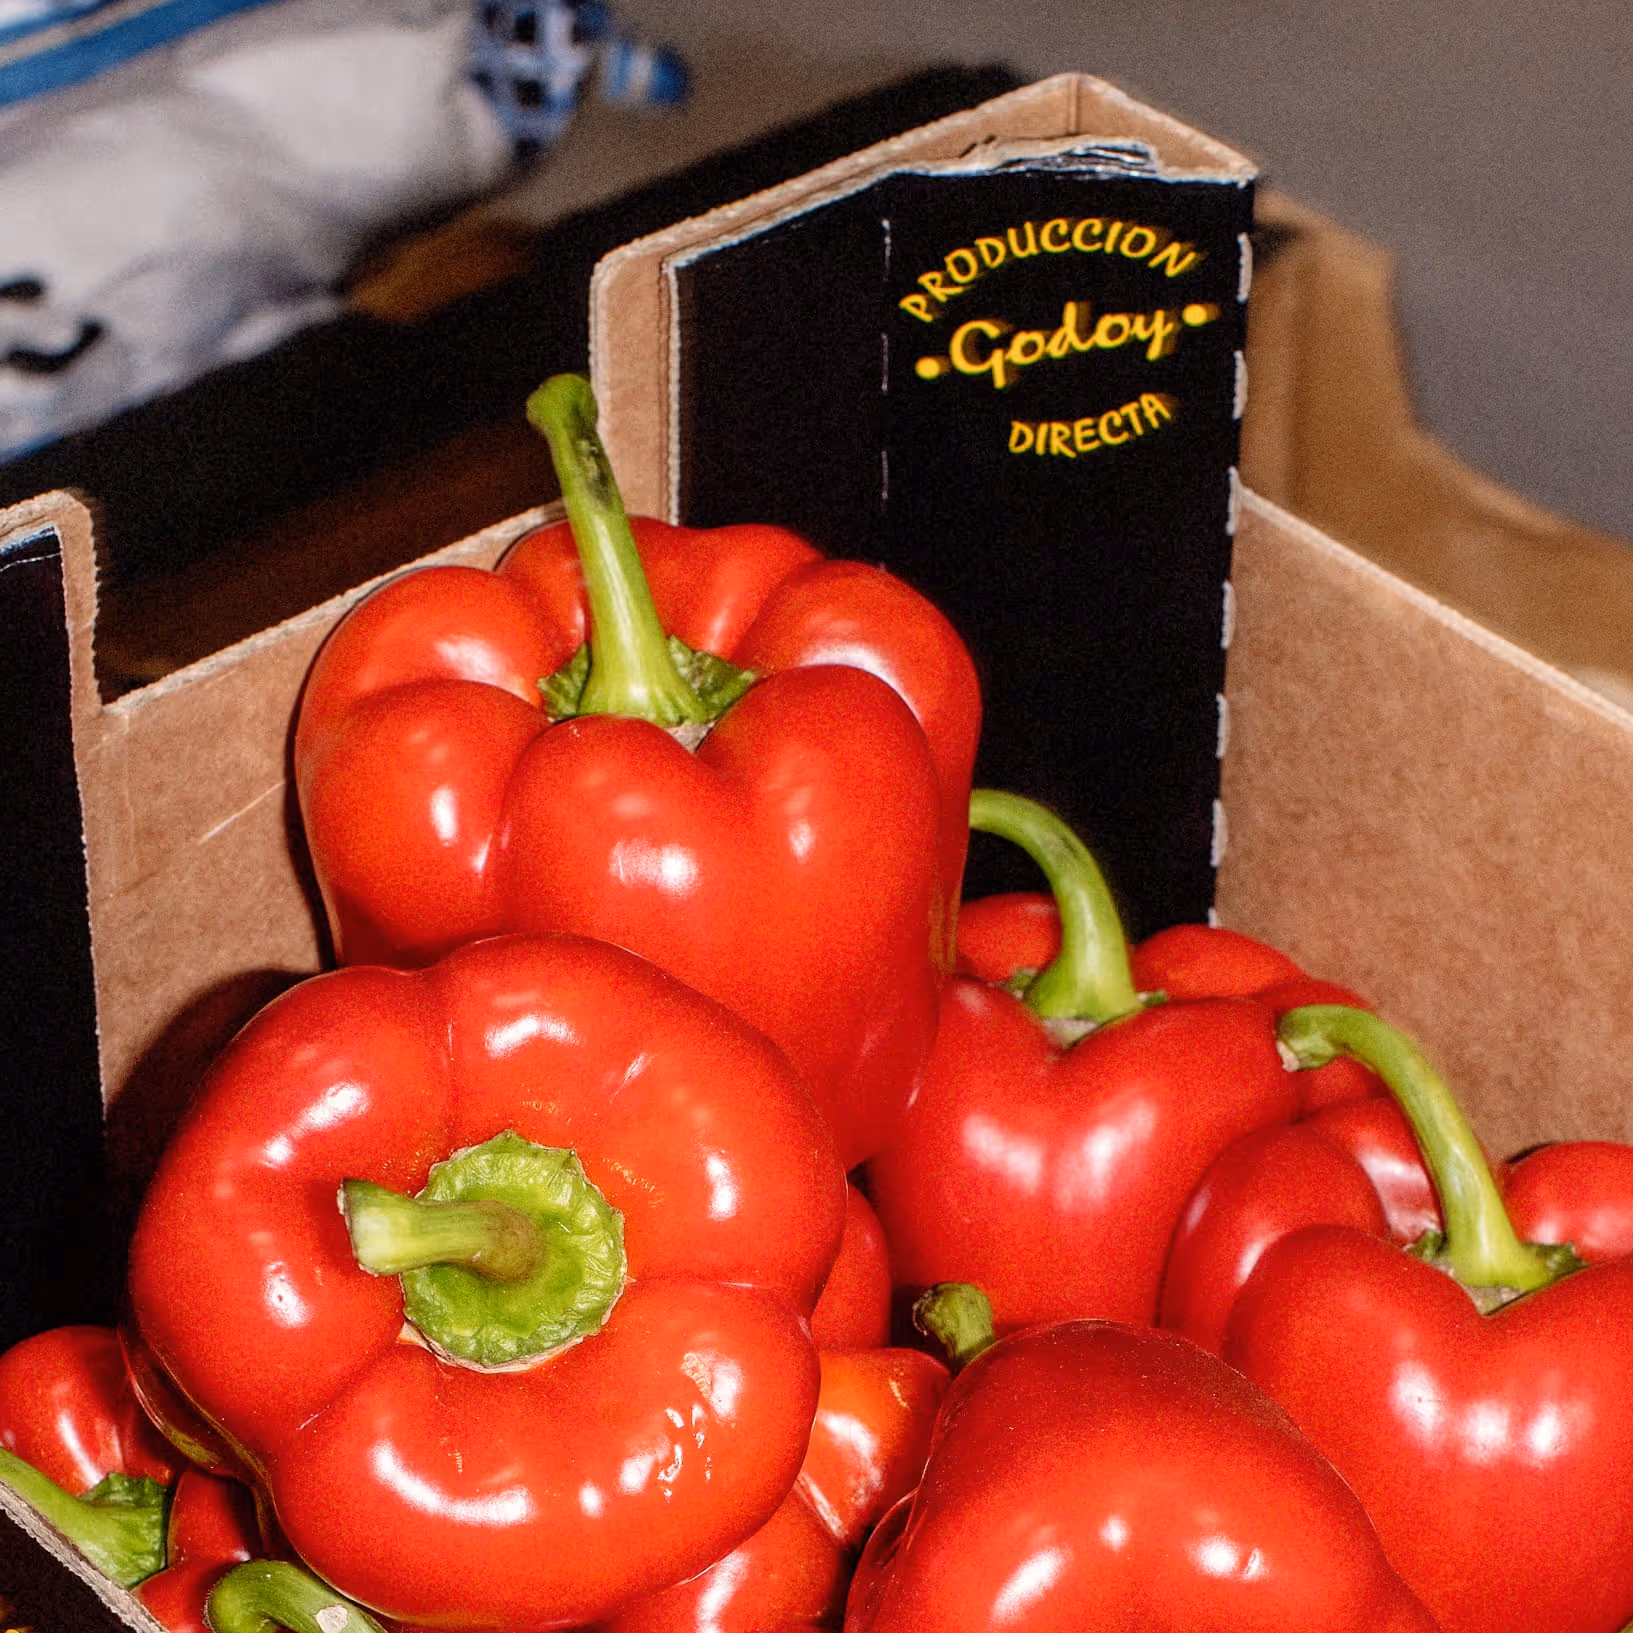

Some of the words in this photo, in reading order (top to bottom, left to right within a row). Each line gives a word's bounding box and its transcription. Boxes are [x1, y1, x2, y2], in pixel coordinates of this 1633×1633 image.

[898, 218, 1196, 322] PRODUCCION
[950, 301, 1173, 389] Godoy
[1009, 394, 1170, 458] DIRECTA
